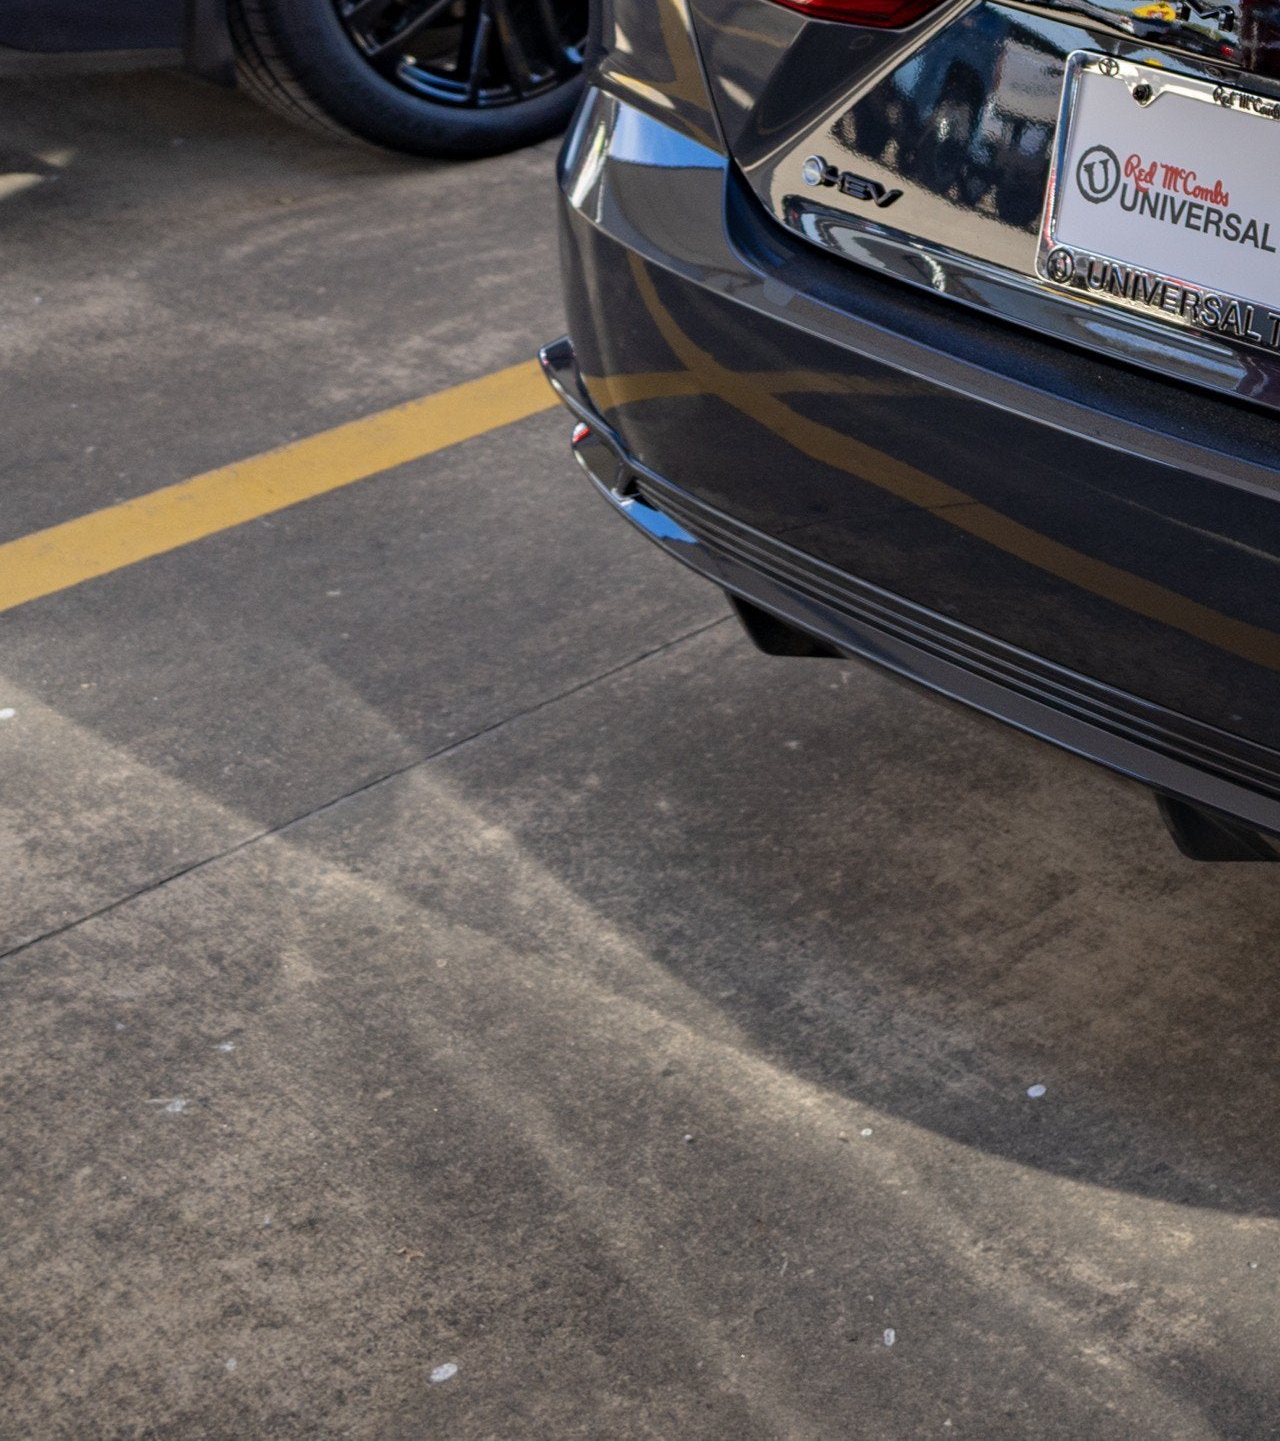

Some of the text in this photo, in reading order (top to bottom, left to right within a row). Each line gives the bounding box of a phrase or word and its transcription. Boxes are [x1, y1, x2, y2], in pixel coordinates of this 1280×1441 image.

[1124, 153, 1230, 207] Red McCombs
[1120, 182, 1277, 254] UNIVERSAL
[1086, 256, 1262, 342] UNIVERSAL
